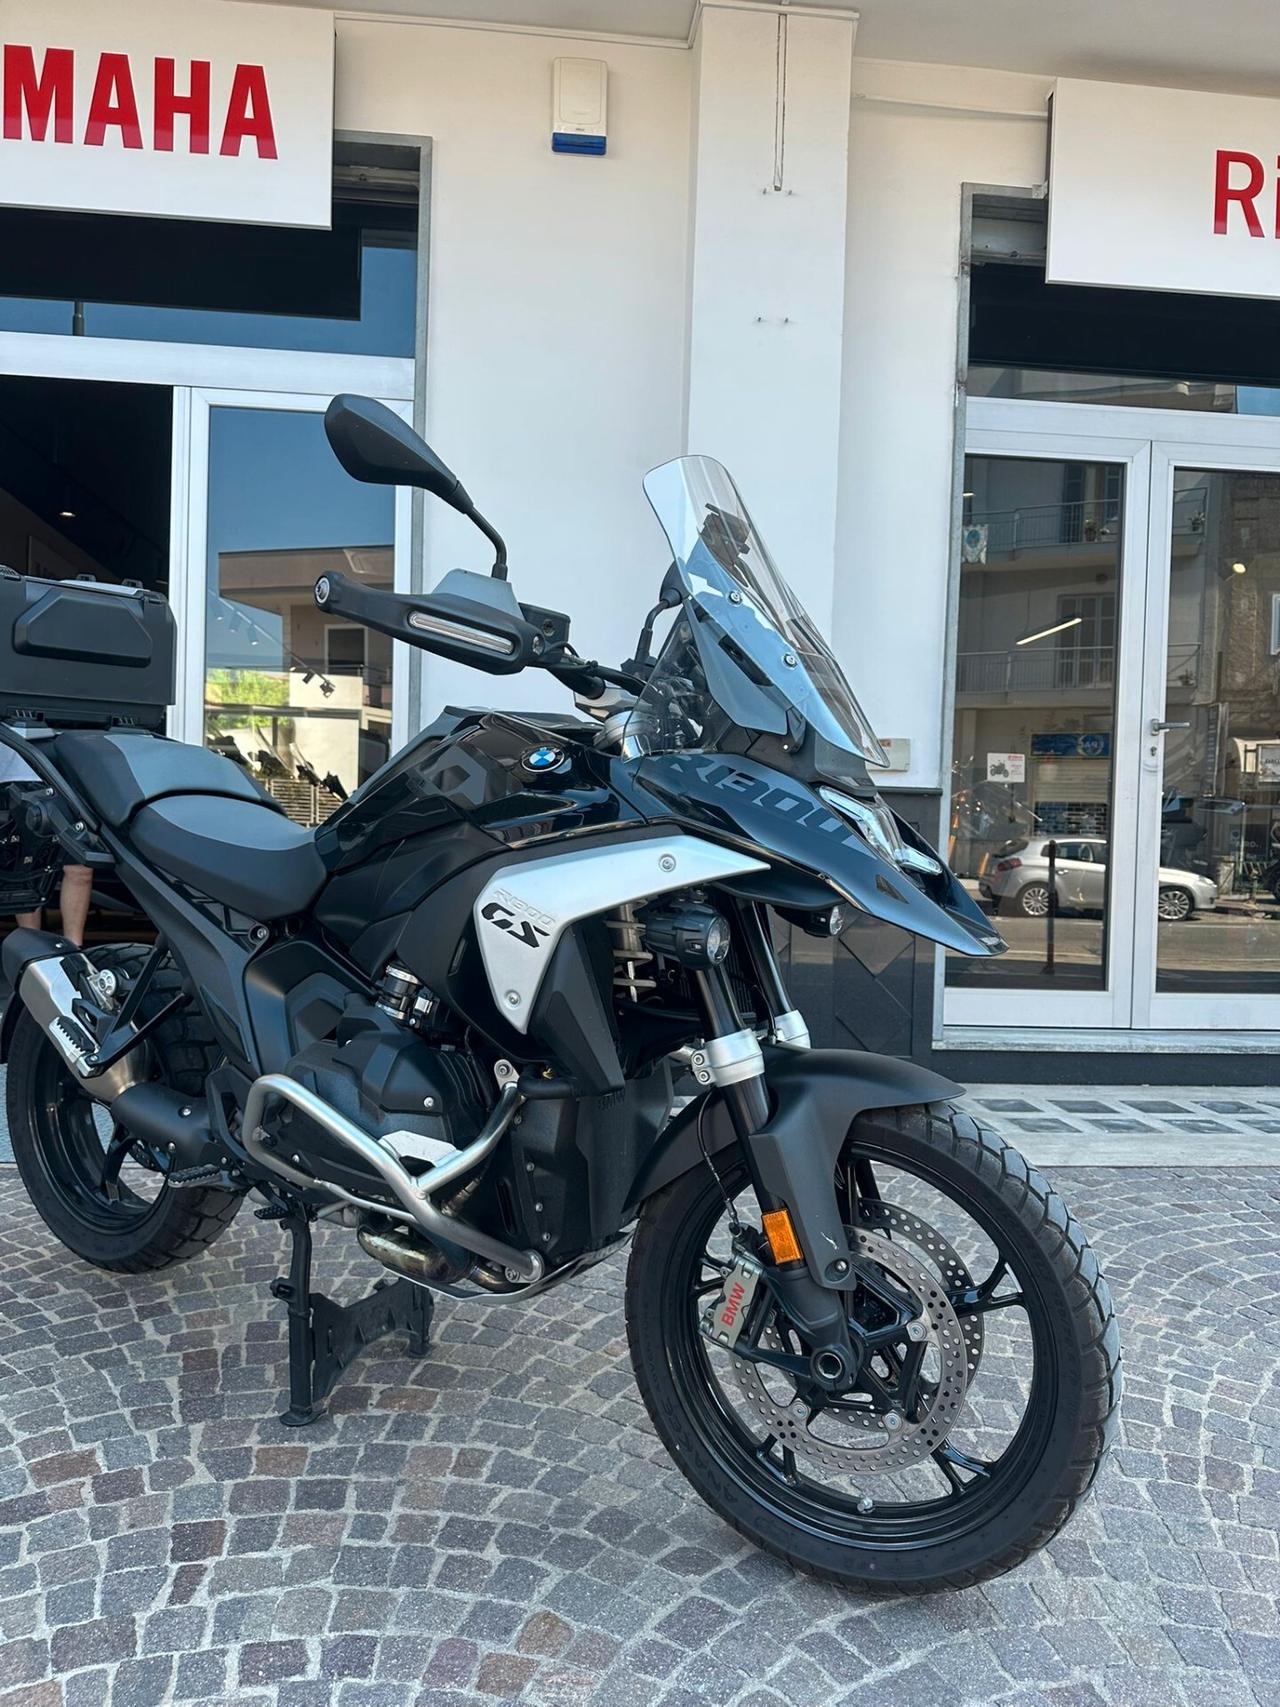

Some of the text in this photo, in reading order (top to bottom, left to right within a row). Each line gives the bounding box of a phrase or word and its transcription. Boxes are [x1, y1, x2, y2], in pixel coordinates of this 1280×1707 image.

[3, 44, 278, 160] MAHA
[481, 902, 551, 948] GS
[720, 1282, 746, 1327] BMW
